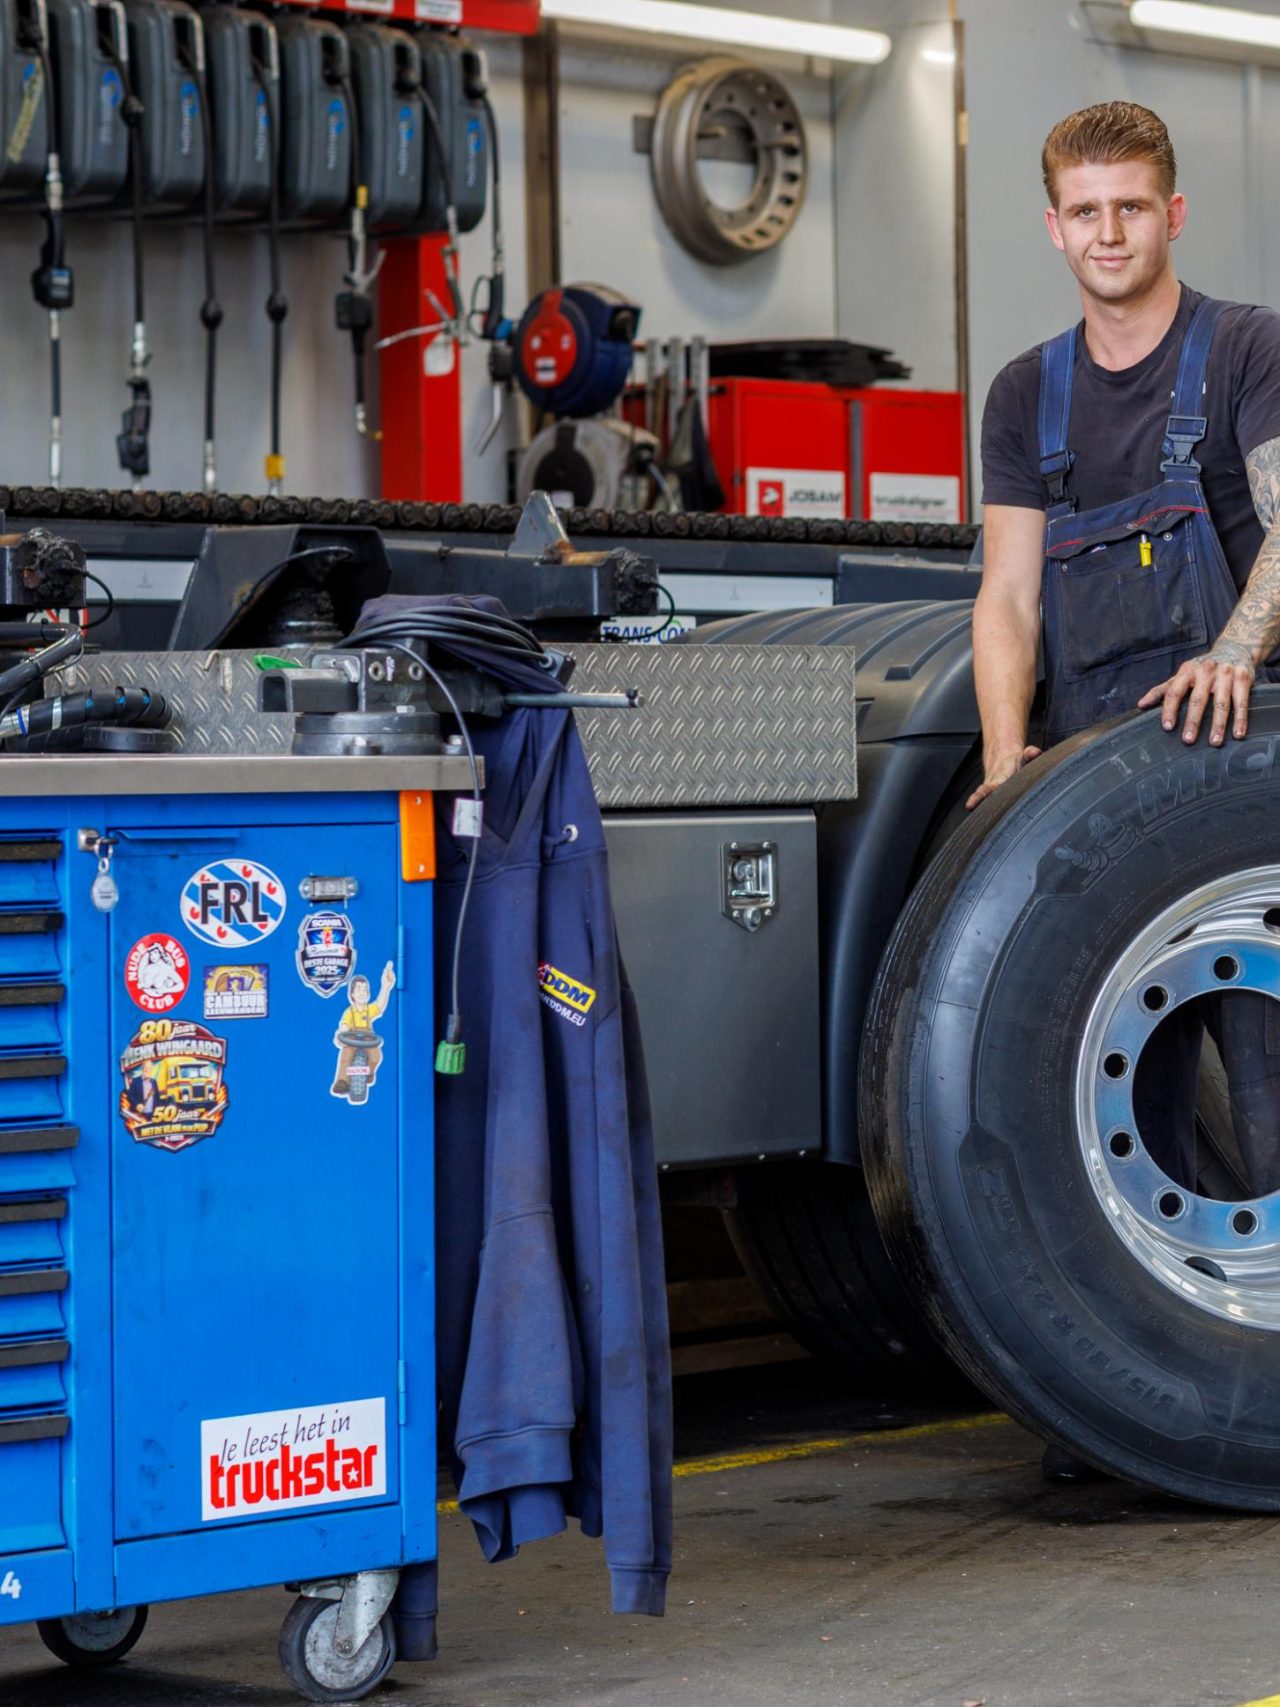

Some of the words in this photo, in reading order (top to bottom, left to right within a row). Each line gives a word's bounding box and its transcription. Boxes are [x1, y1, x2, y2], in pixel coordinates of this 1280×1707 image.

[200, 881, 269, 925] FRL
[128, 942, 148, 982] NUDE
[165, 940, 186, 968] BUS
[139, 994, 174, 1009] CLUB
[139, 1019, 172, 1043] 80
[168, 1024, 197, 1040] jaar
[152, 1105, 177, 1123] 50
[216, 1438, 238, 1474] Je
[243, 1422, 289, 1458] leest
[294, 1413, 327, 1445] het
[331, 1409, 351, 1435] in
[210, 1438, 378, 1509] truckstar
[0, 1571, 22, 1599] 4
